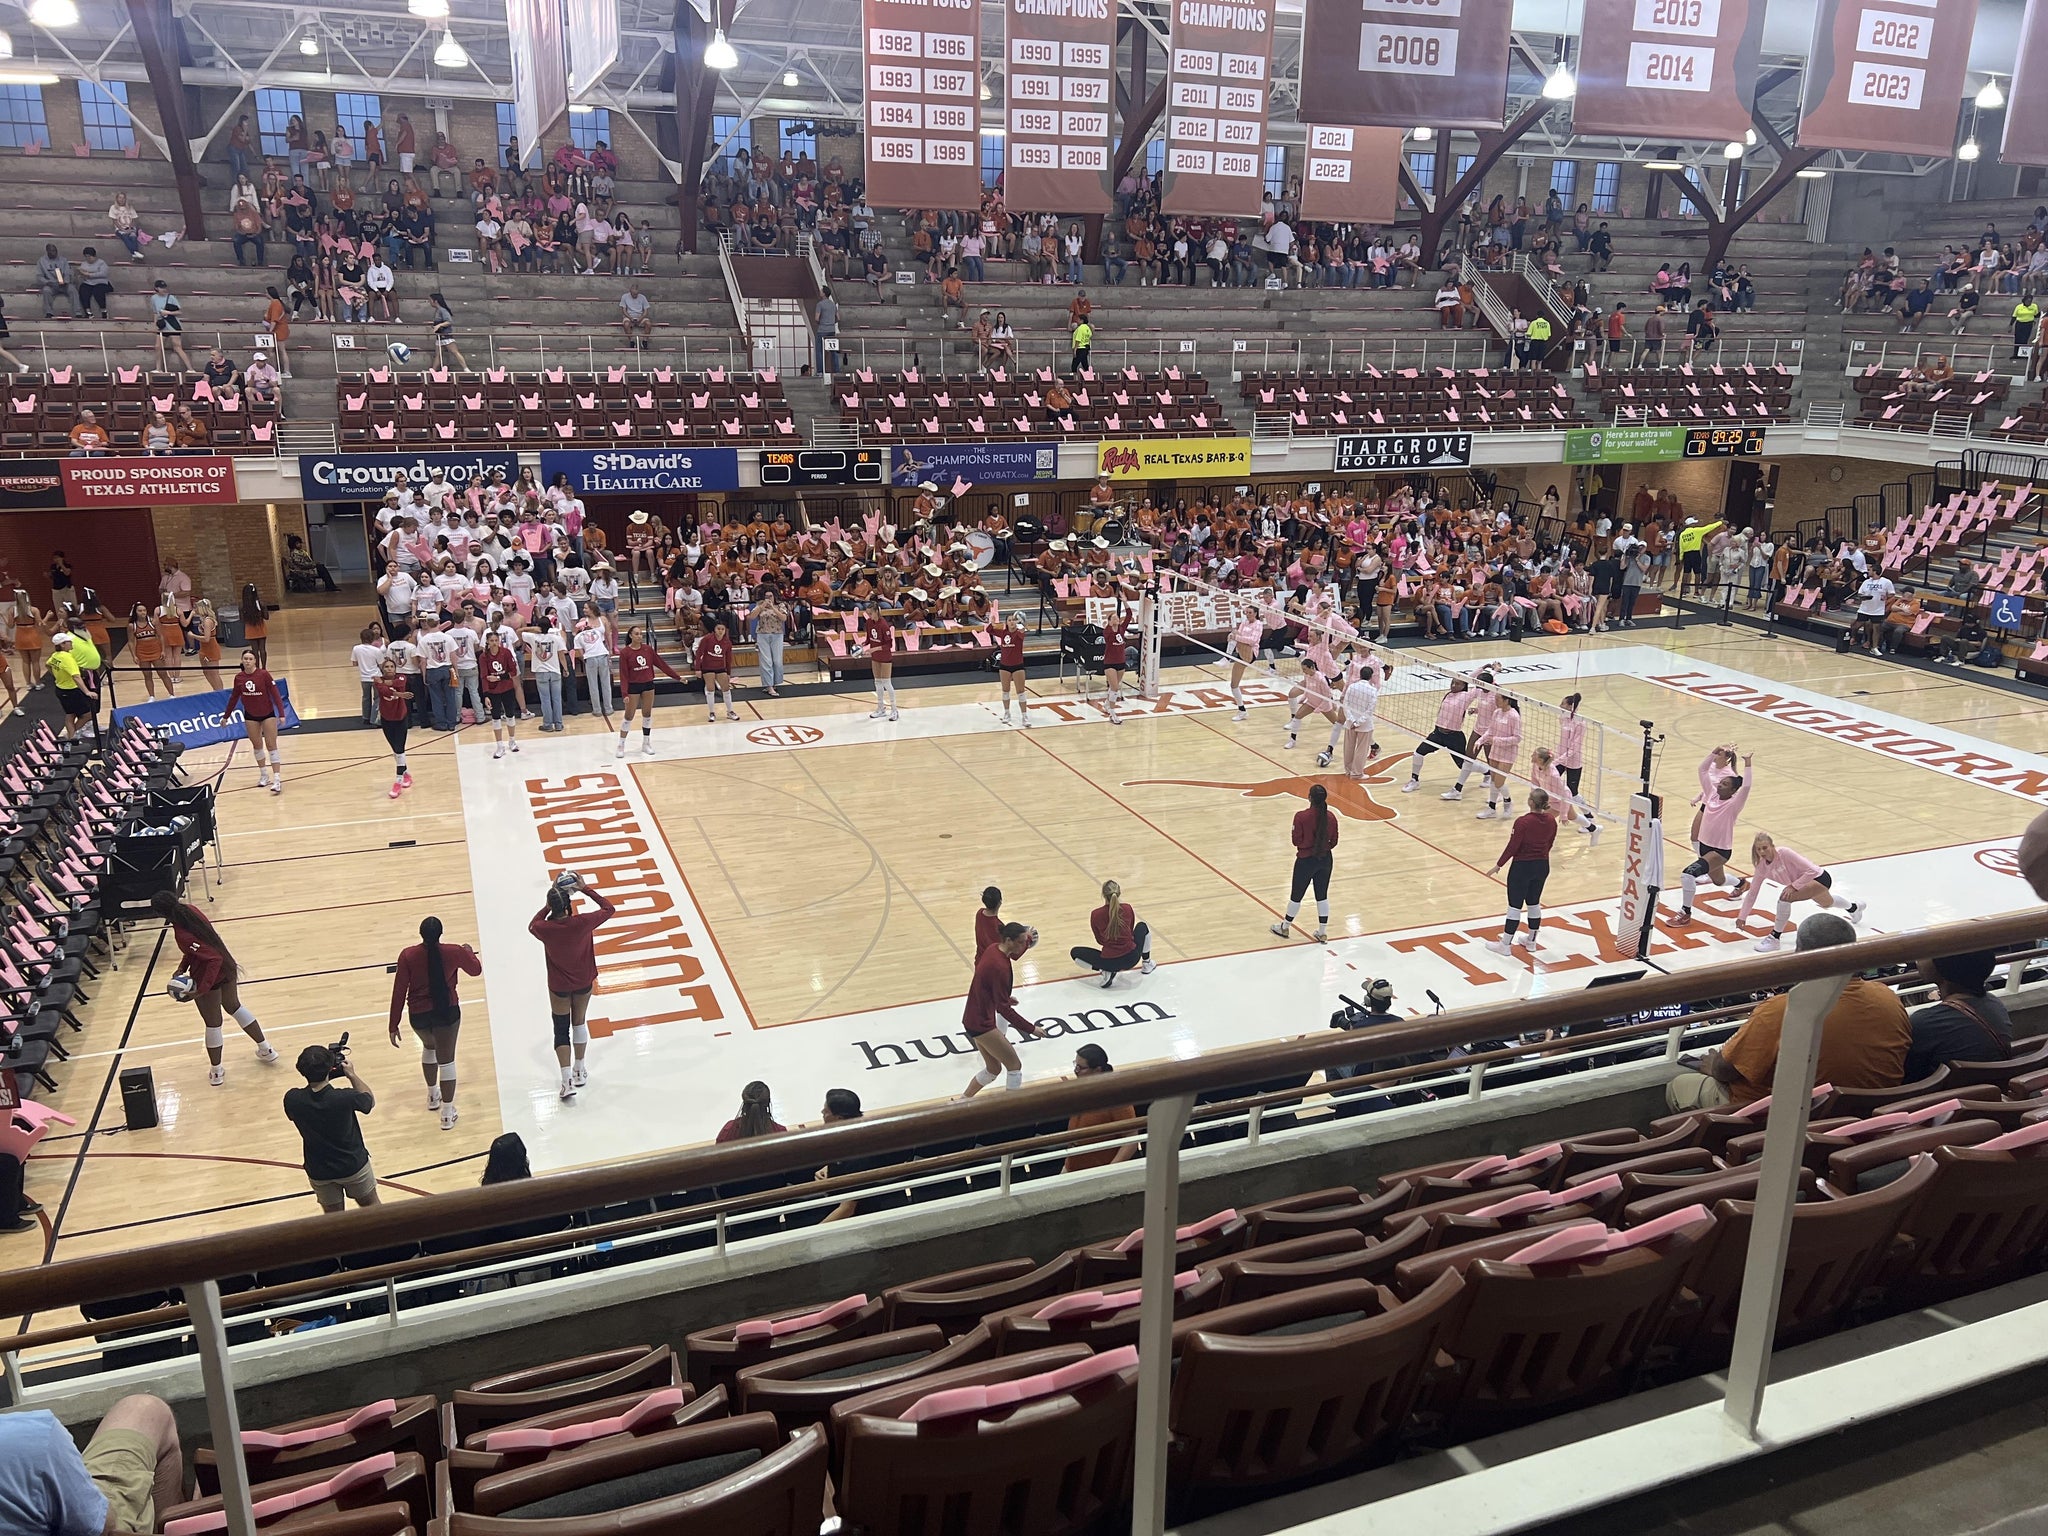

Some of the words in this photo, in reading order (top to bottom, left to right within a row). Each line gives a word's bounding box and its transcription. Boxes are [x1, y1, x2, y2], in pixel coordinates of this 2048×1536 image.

[1014, 0, 1108, 20] CHAMPIONS
[1180, 1, 1267, 32] CHAMPIONS
[1653, 0, 1702, 27] 2013
[1872, 20, 1919, 50] 2022
[879, 34, 912, 52] 1982
[933, 39, 965, 55] 1986
[1378, 35, 1440, 66] 2008
[1020, 45, 1051, 61] 1990
[1071, 48, 1102, 64] 1995
[1180, 55, 1213, 70] 2009
[1229, 59, 1257, 75] 2014
[1646, 53, 1694, 82] 2014
[880, 71, 912, 87] 1983
[933, 75, 966, 91] 1987
[1021, 80, 1050, 96] 1991
[1071, 83, 1101, 98] 1997
[1863, 72, 1911, 100] 2023
[1182, 88, 1207, 104] 2011
[1227, 92, 1255, 108] 2015
[880, 107, 913, 123] 1984
[933, 110, 965, 126] 1988
[1020, 114, 1051, 130] 1992
[1069, 117, 1102, 132] 2007
[1178, 122, 1207, 137] 2012
[1225, 125, 1253, 140] 2017
[1319, 132, 1346, 147] 2021
[880, 142, 913, 158] 1985
[934, 145, 965, 160] 1989
[1020, 149, 1050, 164] 1993
[1068, 151, 1101, 166] 2008
[1177, 154, 1205, 169] 2013
[1223, 158, 1251, 172] 2018
[1316, 163, 1345, 178] 2022
[261, 338, 270, 346] 31
[341, 339, 350, 347] 32
[762, 342, 770, 350] 32
[828, 342, 837, 350] 33
[1606, 430, 1629, 439] Here's
[1713, 431, 1741, 444] 39:25
[1343, 437, 1467, 455] HARGROVE
[1605, 440, 1616, 448] for
[1616, 440, 1633, 449] your
[1635, 439, 1658, 447] wallet.
[1698, 441, 1706, 455] 0
[1755, 440, 1763, 451] 0
[767, 453, 794, 464] TEXAS
[858, 452, 868, 462] OU
[927, 454, 991, 465] CHAMPIONS
[993, 453, 1032, 464] RETURN
[1102, 447, 1140, 474] Rudy's
[1144, 454, 1170, 465] REAL
[1171, 453, 1204, 464] TEXAS
[1341, 455, 1421, 467] ROOFING
[71, 468, 126, 480] PROUD
[130, 467, 204, 480] SPONSOR
[208, 467, 227, 478] OF
[82, 484, 135, 496] TEXAS
[139, 482, 220, 495] ATHLETICS
[1026, 684, 1290, 722] TEXAS
[750, 725, 822, 746] SEC
[1624, 809, 1645, 921] TEXAS
[525, 773, 724, 1039] LONGHORNS
[1387, 890, 1798, 986] TEXAS
